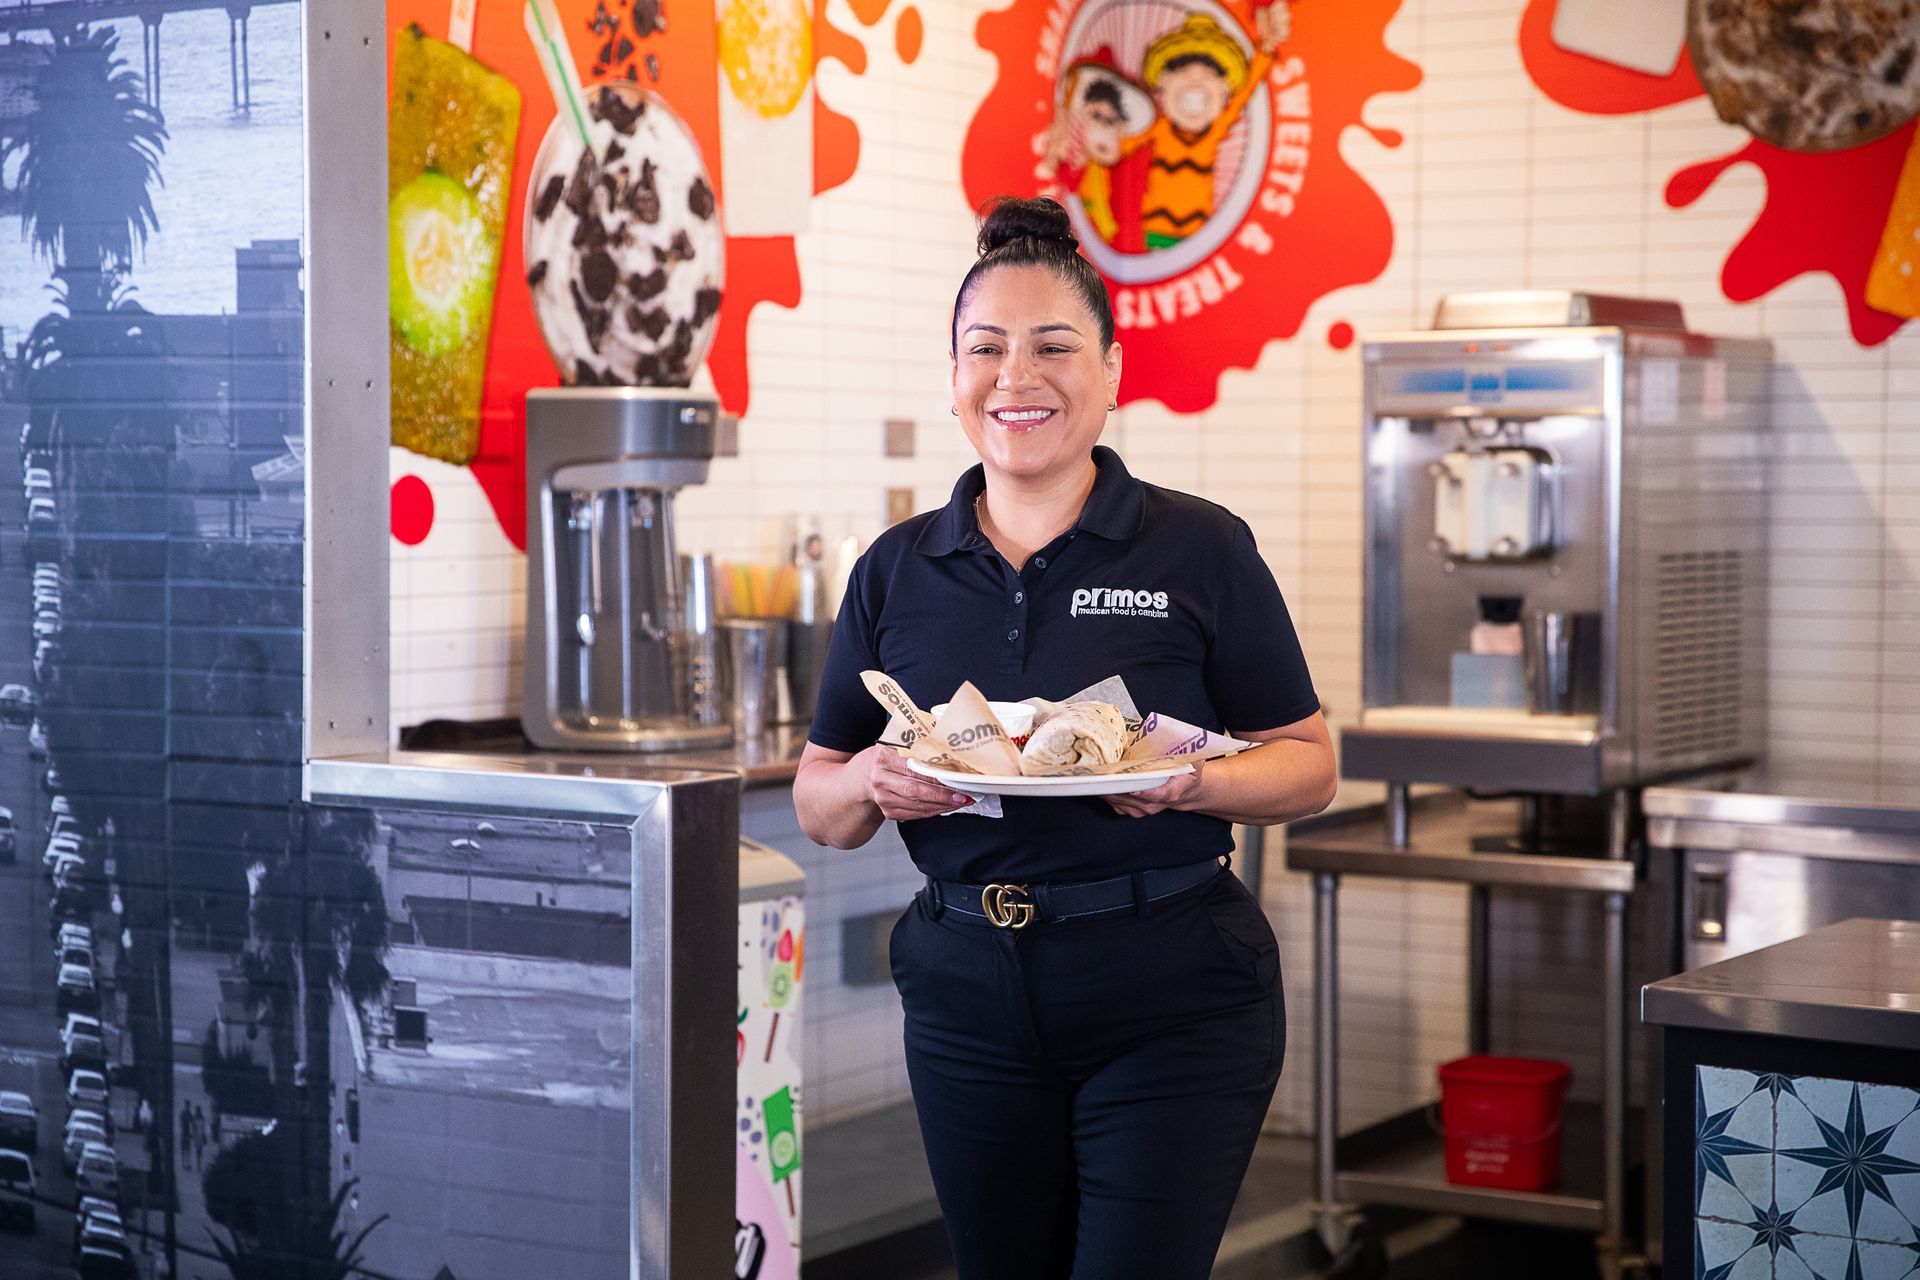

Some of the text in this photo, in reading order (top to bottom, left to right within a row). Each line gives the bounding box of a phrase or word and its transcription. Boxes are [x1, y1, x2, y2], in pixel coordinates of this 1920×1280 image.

[1115, 56, 1312, 329] SWEETS & TREATS
[1070, 588, 1169, 618] primos
[1078, 607, 1169, 618] mexican food & cantina
